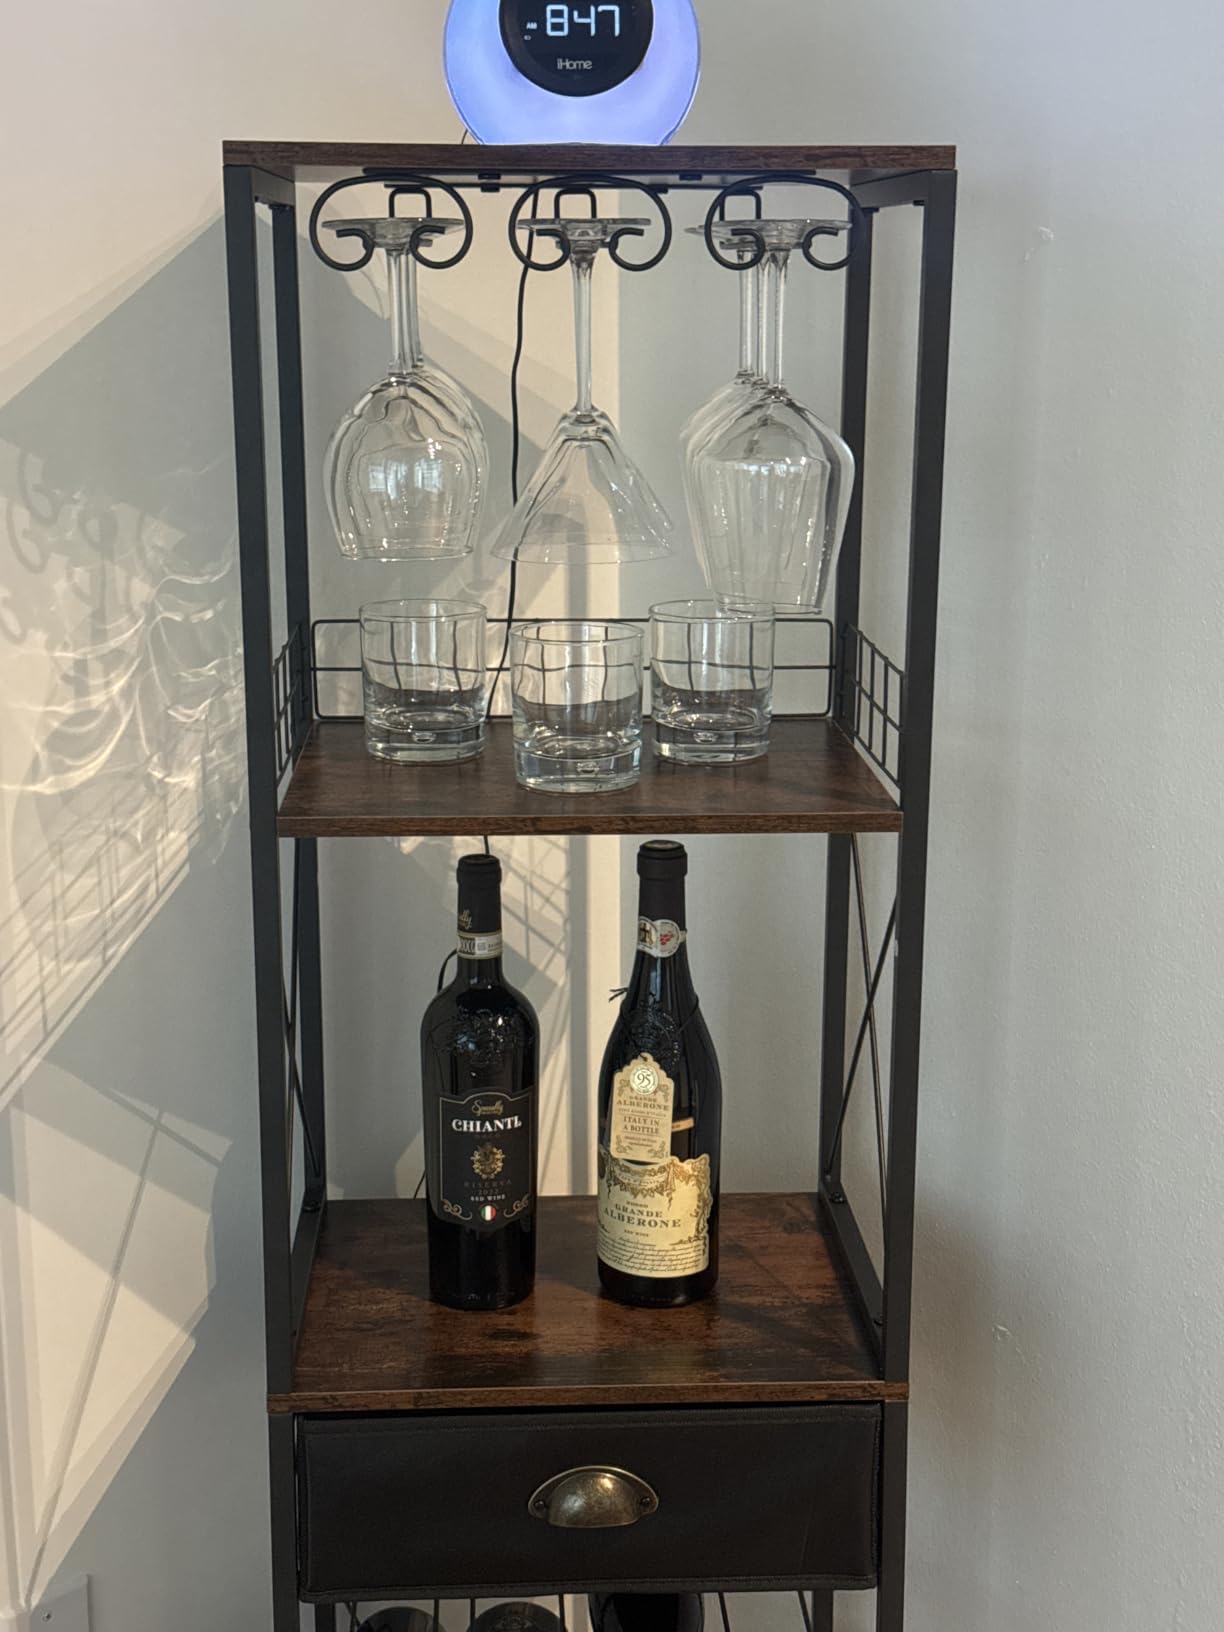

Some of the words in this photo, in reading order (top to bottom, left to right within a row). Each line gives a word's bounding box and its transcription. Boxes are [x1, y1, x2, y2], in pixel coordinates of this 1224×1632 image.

[557, 58, 593, 70] iHome
[636, 1072, 652, 1086] 95
[616, 1099, 670, 1112] ALBERONE
[623, 1115, 648, 1125] ITALY
[650, 1118, 660, 1127] IN
[630, 1125, 660, 1135] BOTTLE
[615, 1203, 663, 1218] GRANDE
[604, 1207, 682, 1229] ALBERONE
